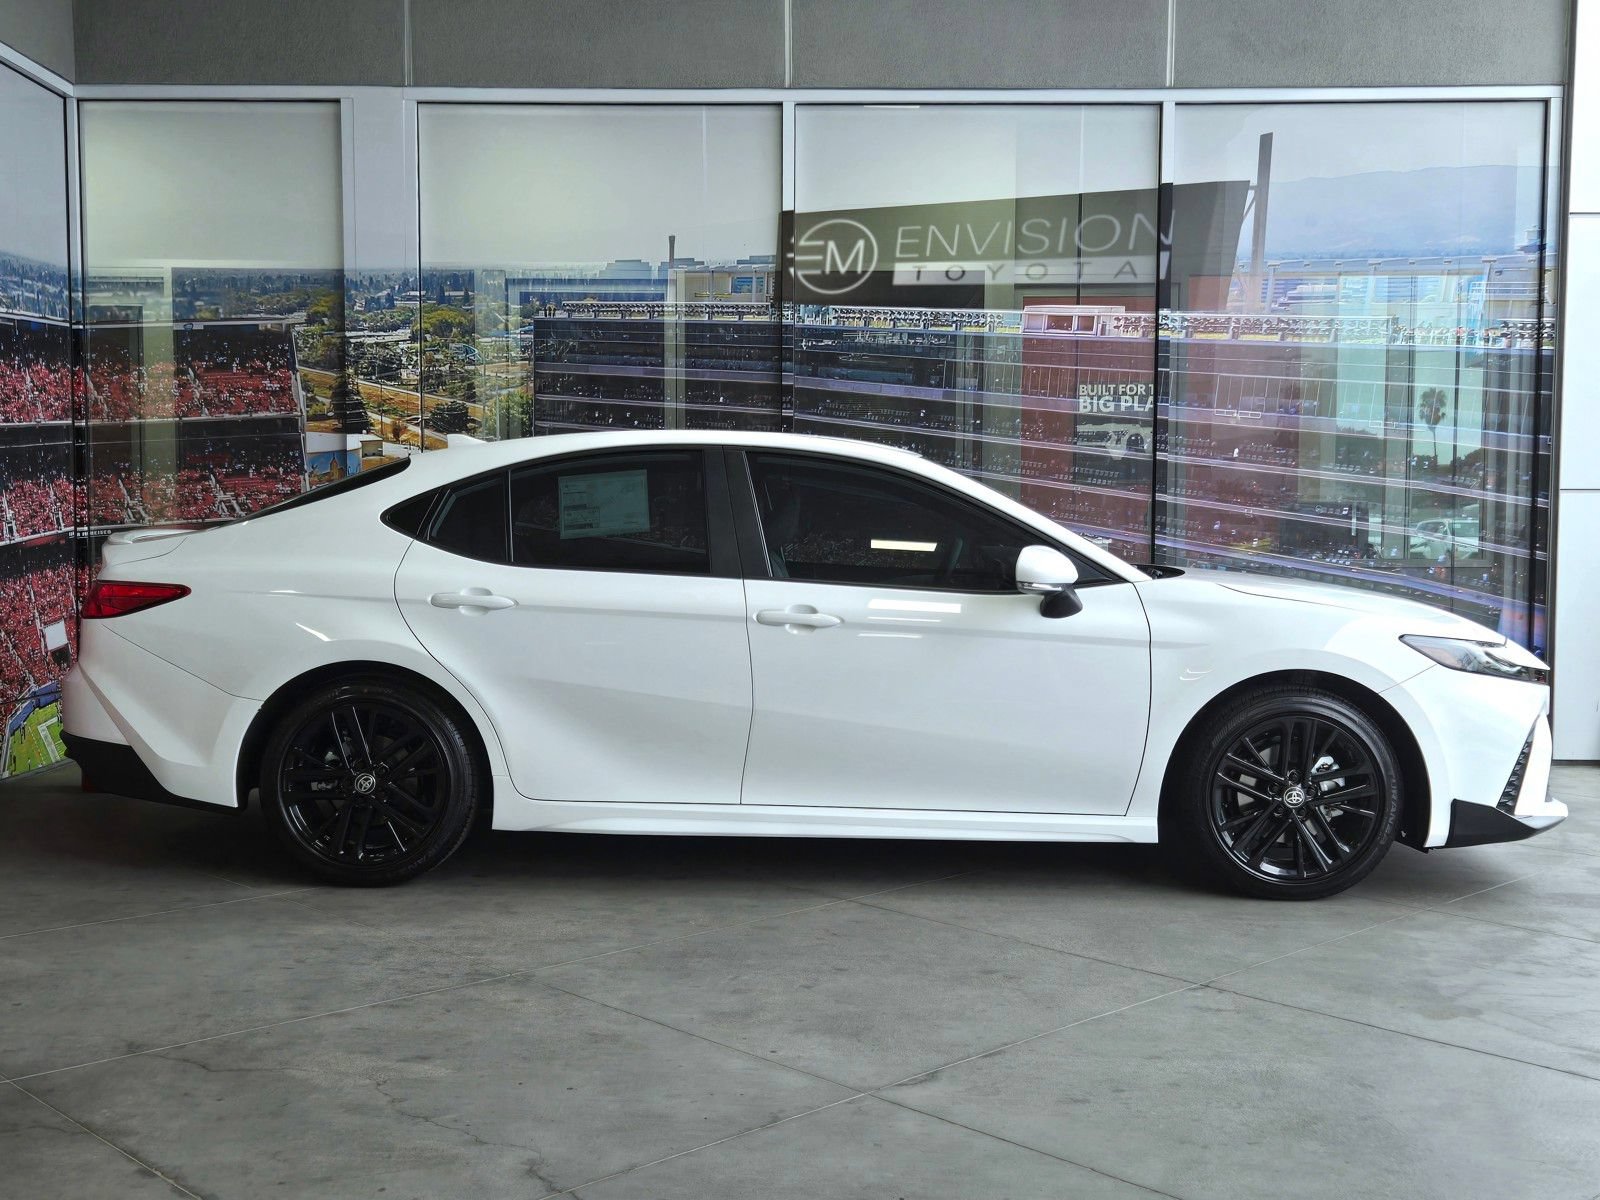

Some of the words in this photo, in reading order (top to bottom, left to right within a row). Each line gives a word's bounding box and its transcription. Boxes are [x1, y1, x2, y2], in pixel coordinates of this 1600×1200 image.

[895, 209, 1176, 258] ENVISION
[912, 259, 1138, 282] TOYOTA
[1079, 384, 1116, 396] BUILT
[1118, 384, 1146, 395] FOR
[1079, 396, 1114, 412] BIG
